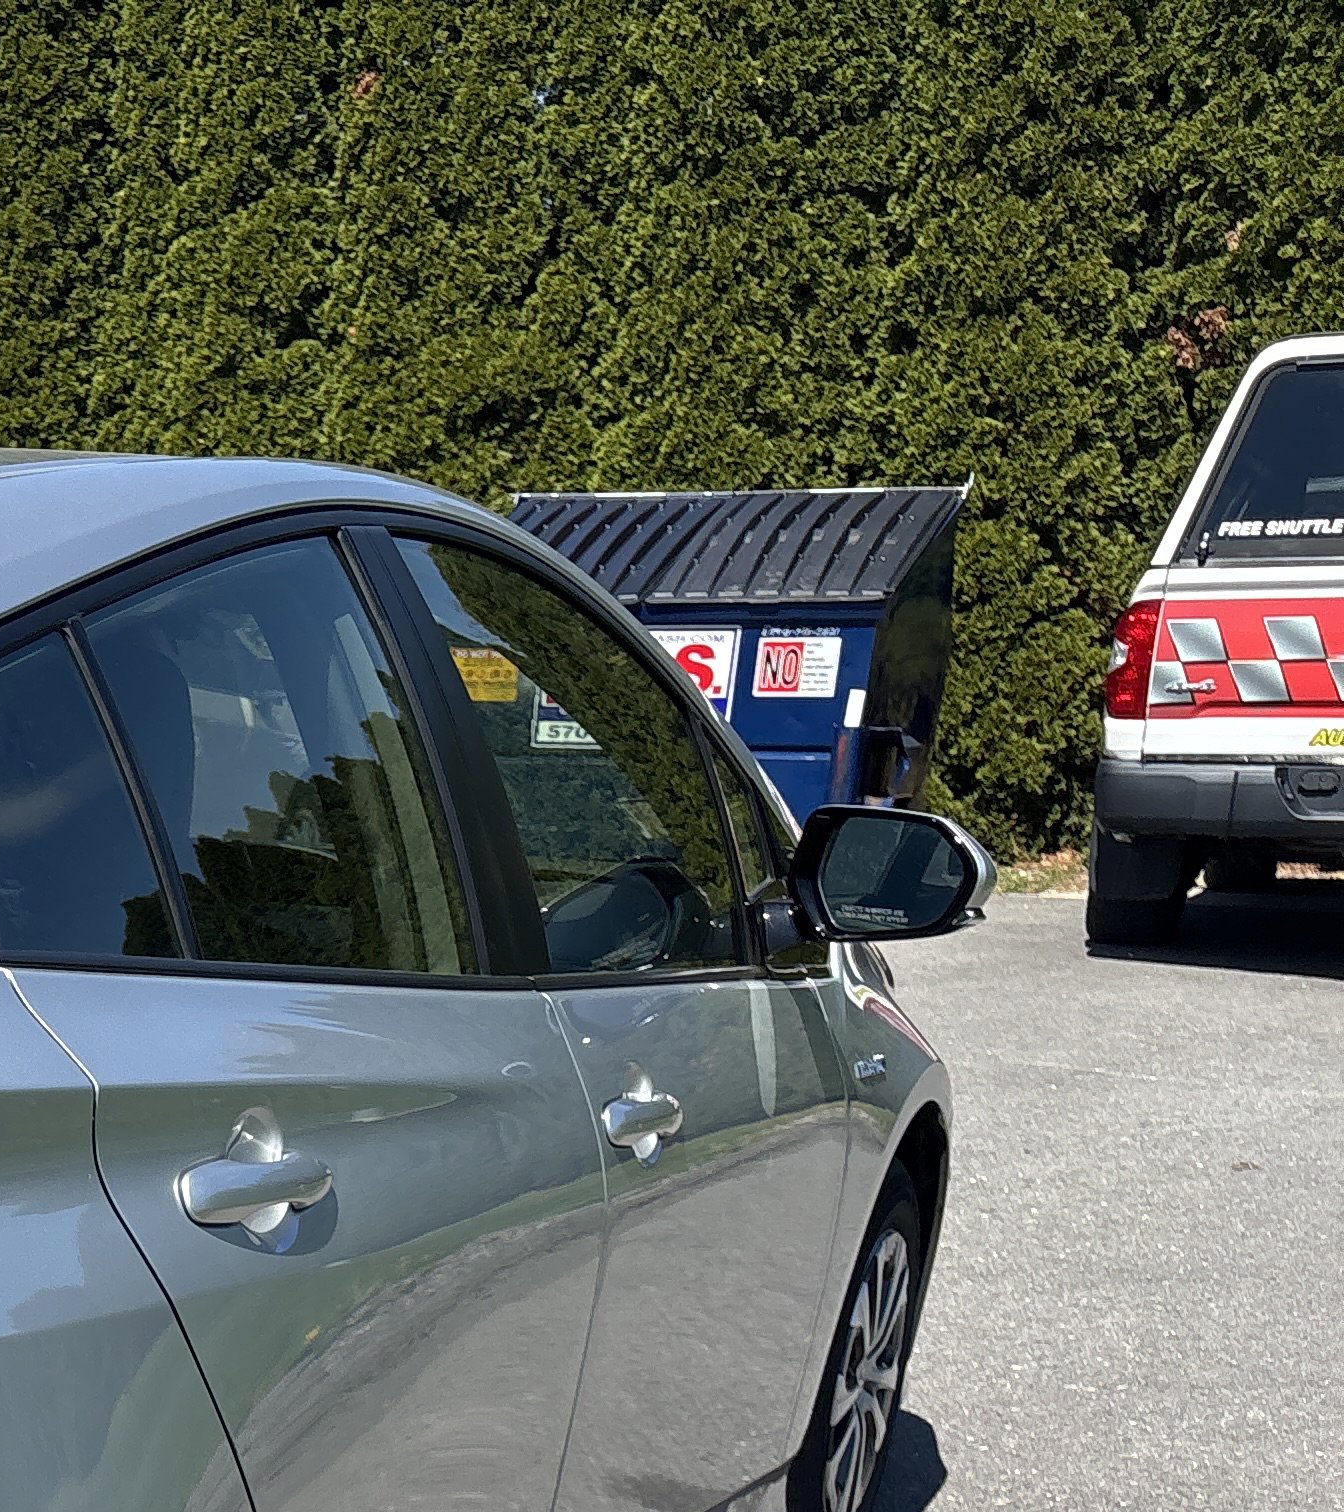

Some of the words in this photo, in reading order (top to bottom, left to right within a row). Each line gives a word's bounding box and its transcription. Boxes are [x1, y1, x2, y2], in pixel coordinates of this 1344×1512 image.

[1218, 521, 1264, 537] FREE
[1265, 519, 1344, 536] SHUTTLE
[759, 645, 802, 689] NO
